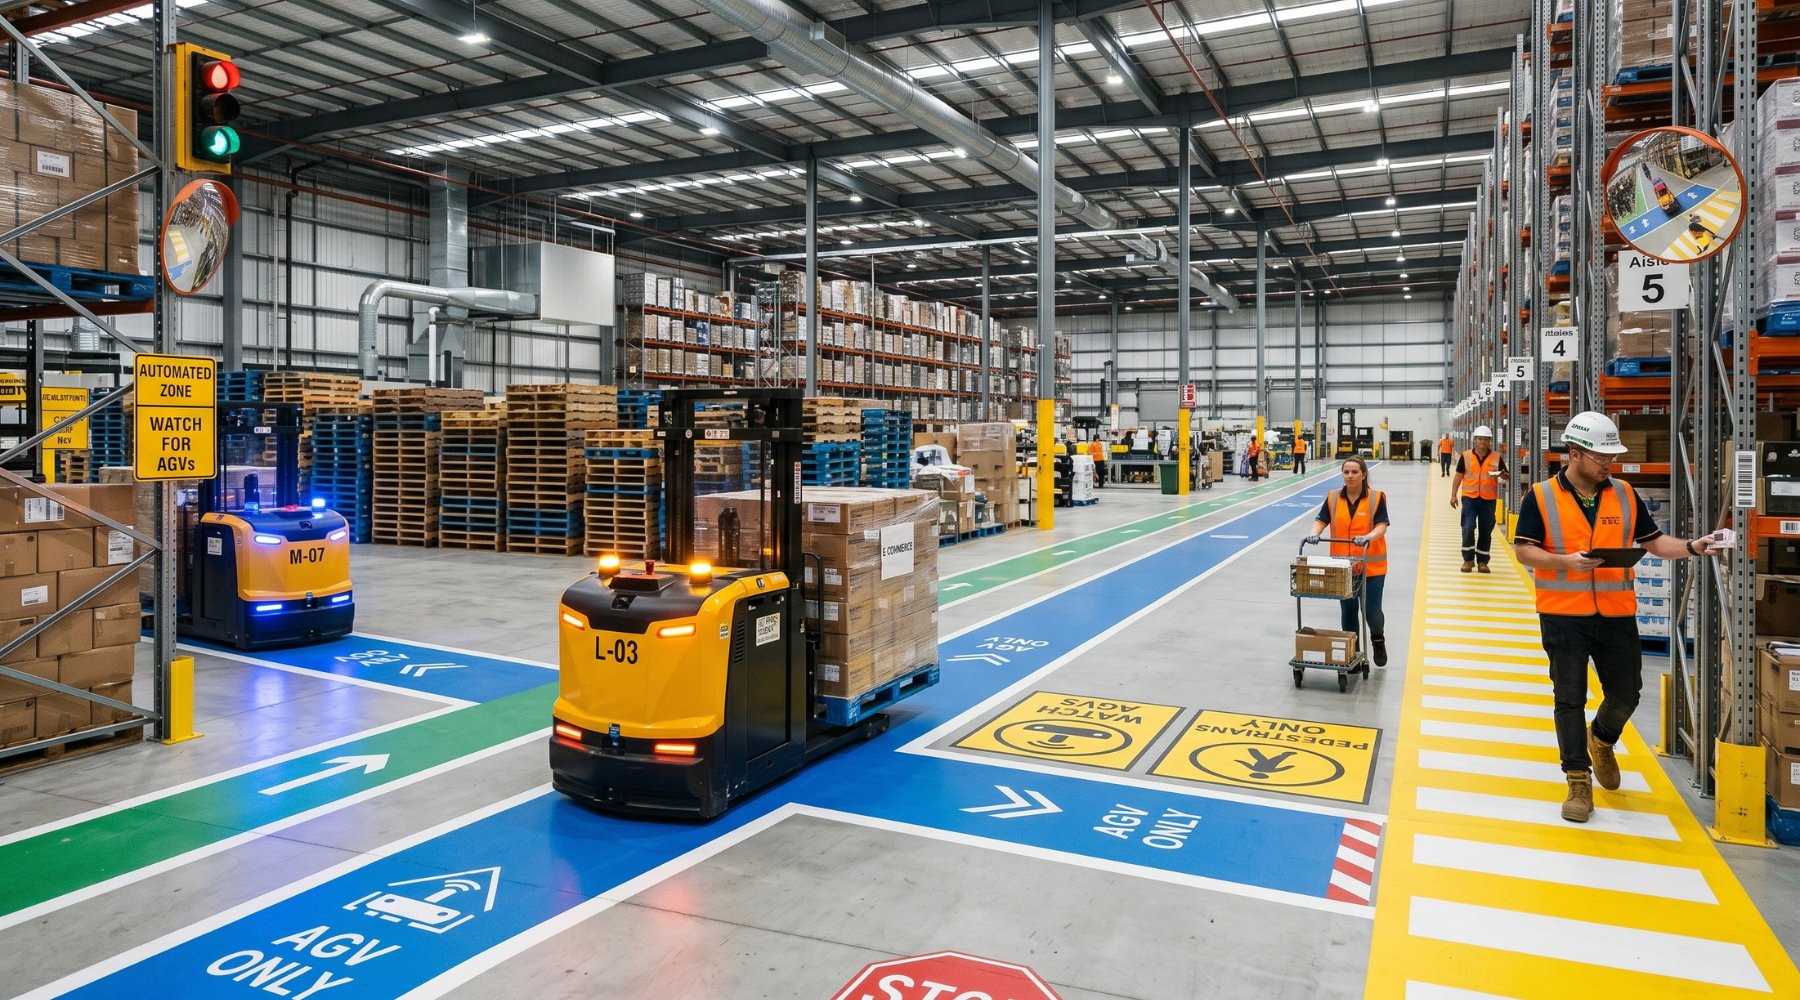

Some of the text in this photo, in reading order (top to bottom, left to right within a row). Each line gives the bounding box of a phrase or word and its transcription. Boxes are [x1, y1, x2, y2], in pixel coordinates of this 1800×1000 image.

[1641, 273, 1665, 304] 5
[1552, 339, 1566, 357] 4
[139, 363, 212, 380] AUTOMATED
[1516, 365, 1525, 378] 5
[160, 383, 192, 398] ZONE
[1497, 378, 1506, 389] 4
[150, 416, 202, 432] WATCH
[162, 436, 191, 452] FOR
[157, 456, 195, 472] AGVs
[289, 547, 325, 565] M-07
[595, 635, 638, 665] L-03
[975, 642, 1035, 652] AGV
[984, 636, 1050, 648] ONLY
[1036, 705, 1142, 725] WATCH
[1240, 719, 1326, 735] ONLY
[1195, 724, 1369, 751] PEDESTRIANS
[1093, 803, 1149, 840] AGV
[1142, 807, 1202, 850] ONLY
[270, 925, 402, 966] AGV
[206, 950, 355, 1000] ONLY
